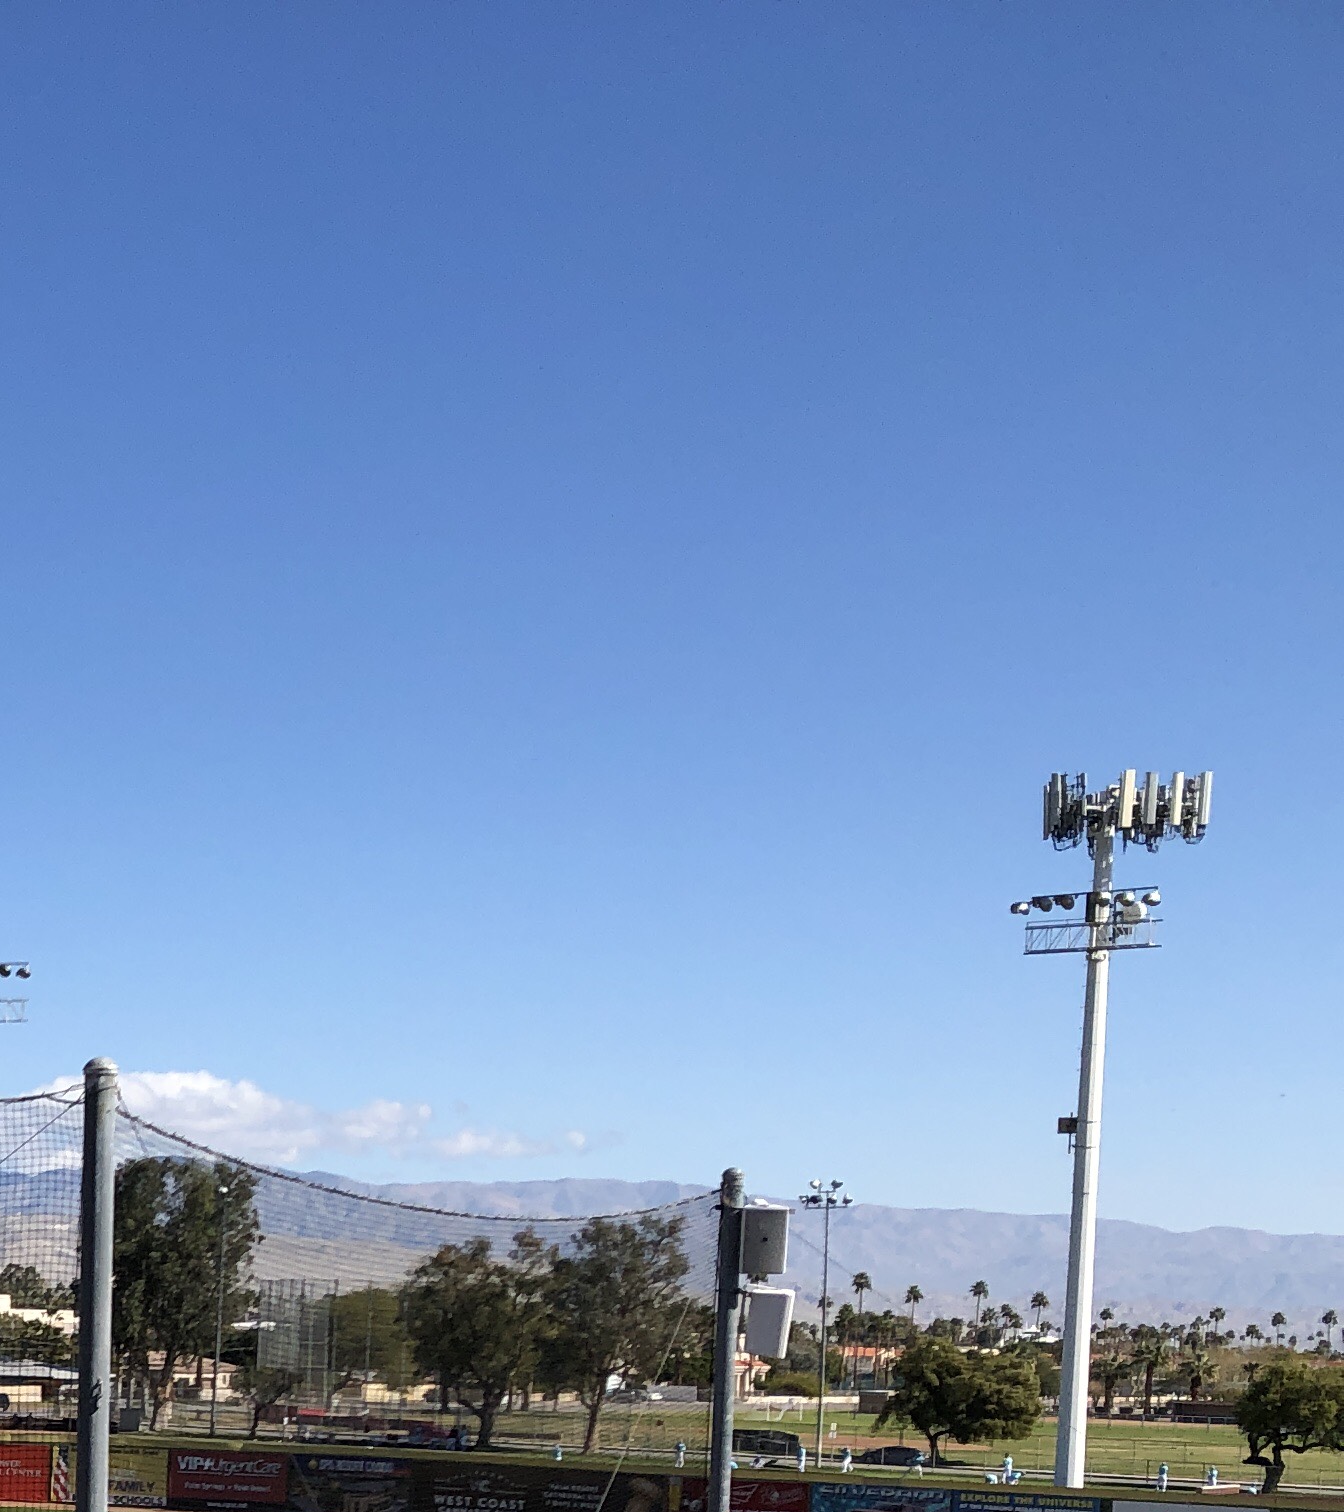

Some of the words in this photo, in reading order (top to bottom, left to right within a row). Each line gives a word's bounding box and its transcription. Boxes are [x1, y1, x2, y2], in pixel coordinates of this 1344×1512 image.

[114, 1496, 163, 1506] SCHOOLS
[434, 1495, 473, 1506] WEST
[477, 1498, 526, 1510] COAST
[960, 1492, 1010, 1504] EXPLORE
[1014, 1496, 1034, 1505] THE
[1038, 1498, 1094, 1508] UNIVERSE
